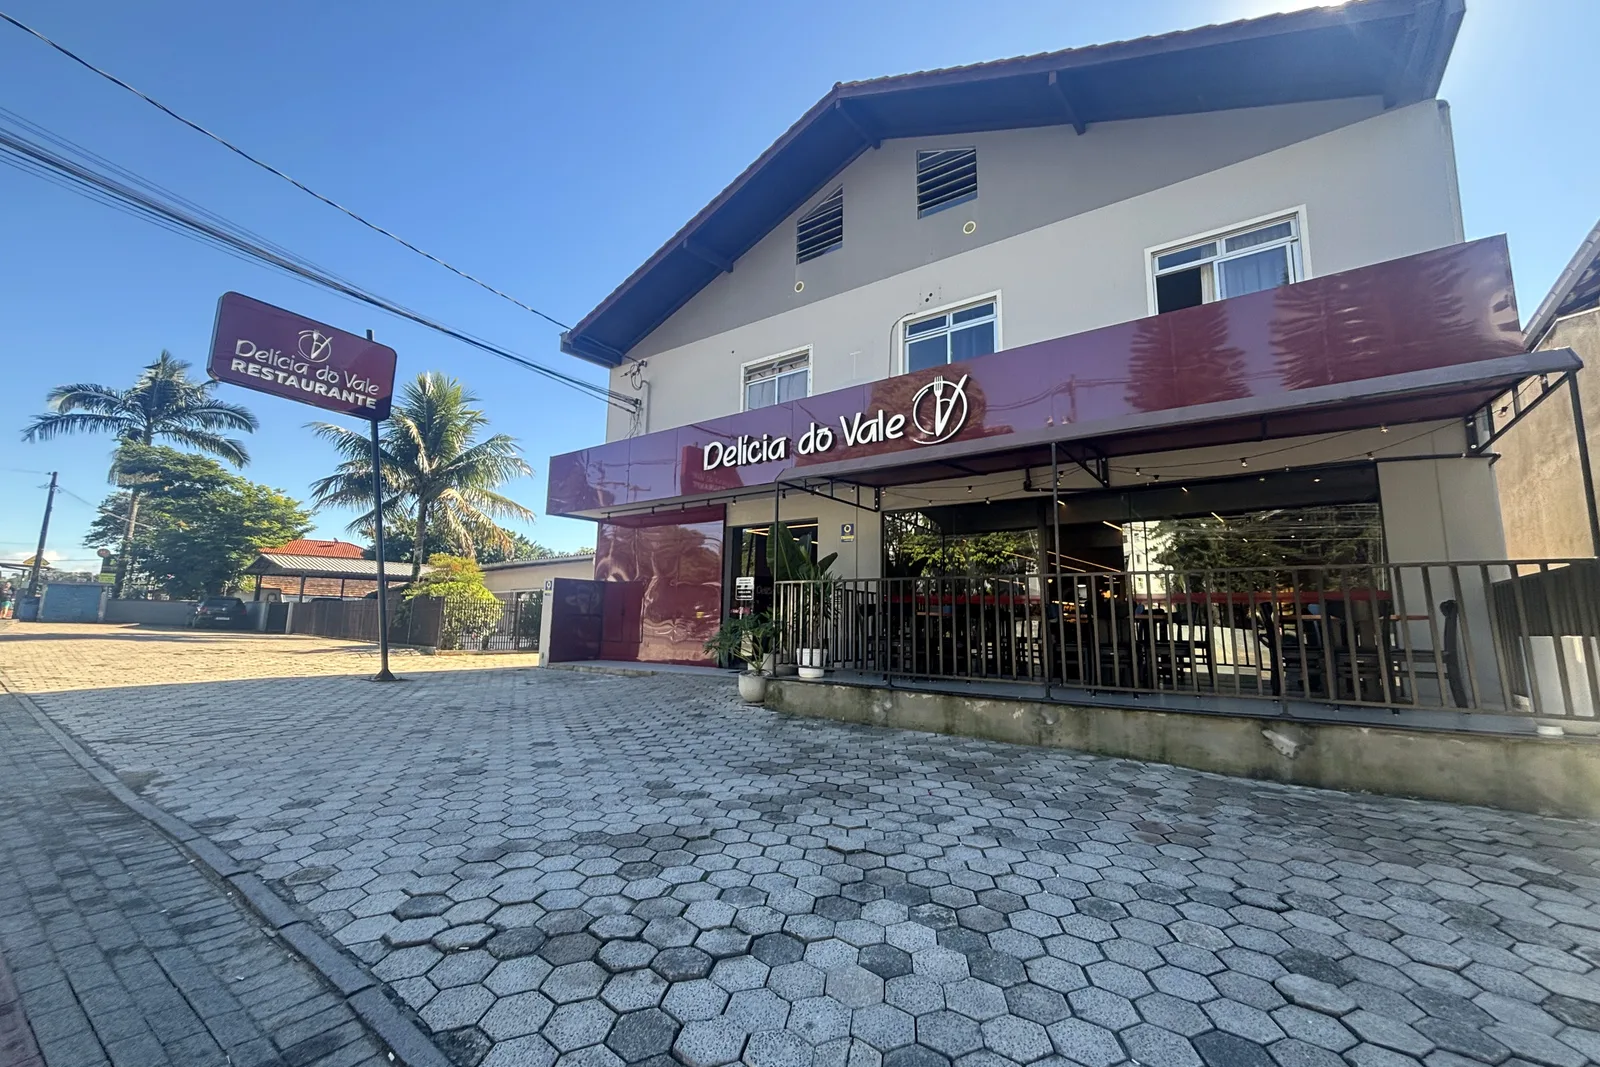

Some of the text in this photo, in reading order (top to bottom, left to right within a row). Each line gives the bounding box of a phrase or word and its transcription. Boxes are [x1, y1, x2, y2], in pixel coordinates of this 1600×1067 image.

[231, 358, 377, 409] RESTAURANTE
[235, 339, 380, 396] Delícia do Vale
[703, 409, 906, 471] Delícia do Vale
